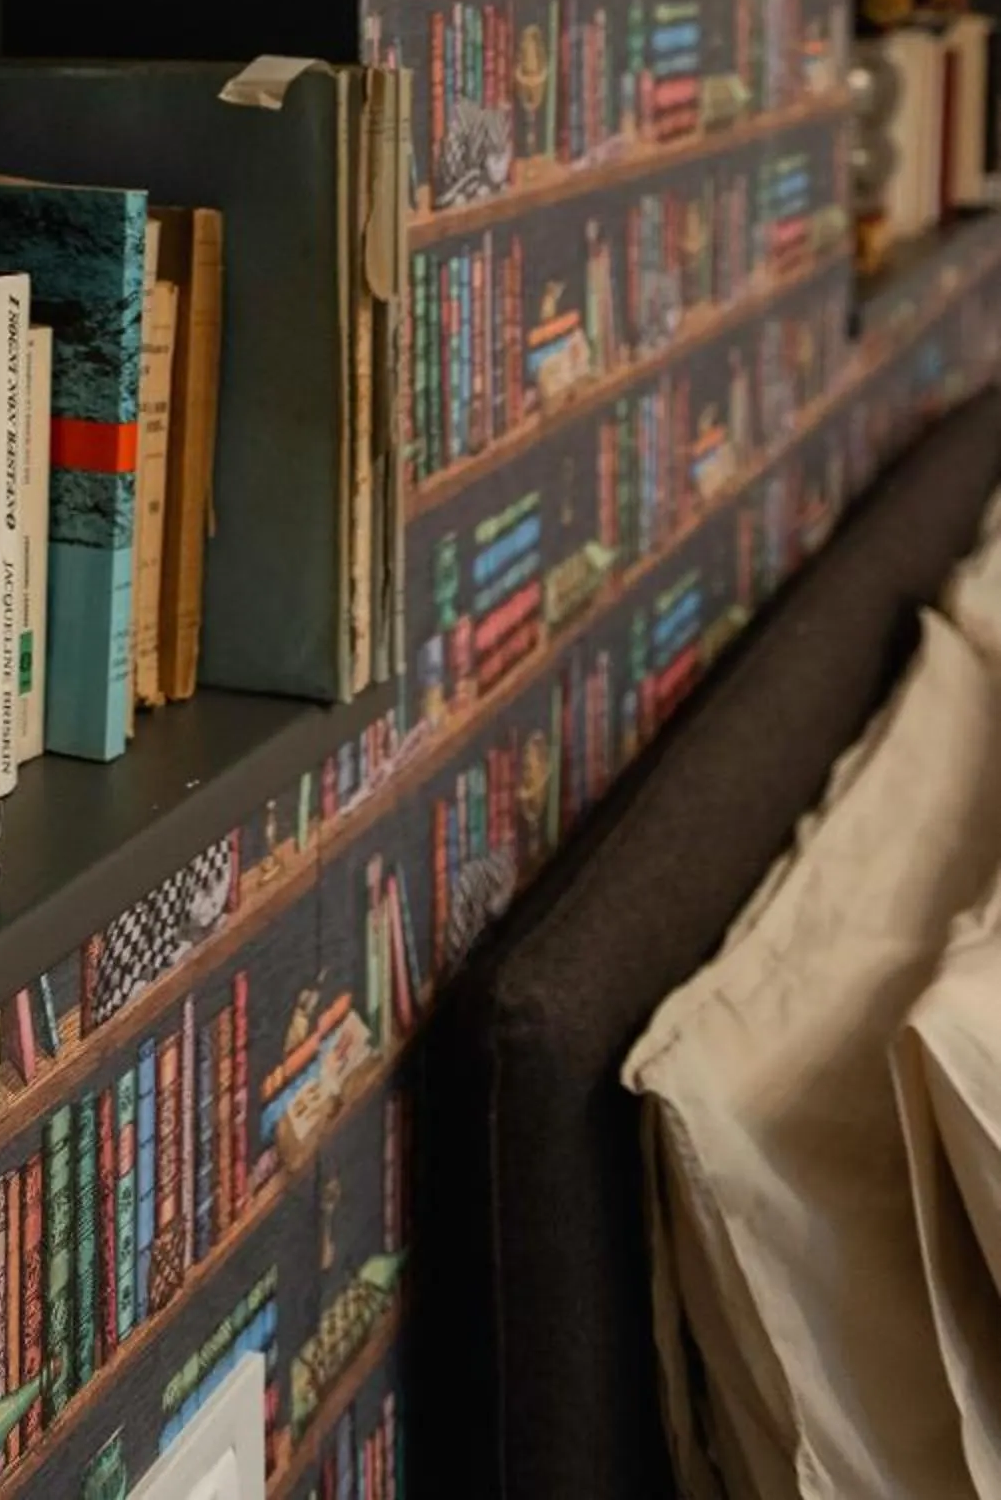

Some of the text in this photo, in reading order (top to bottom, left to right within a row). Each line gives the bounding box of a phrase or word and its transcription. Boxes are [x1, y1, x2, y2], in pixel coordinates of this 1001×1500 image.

[7, 309, 21, 373] SOGNI
[6, 379, 20, 424] NON
[5, 431, 18, 530] BASTANO
[1, 560, 15, 775] JACQUELINE BRISKIN
